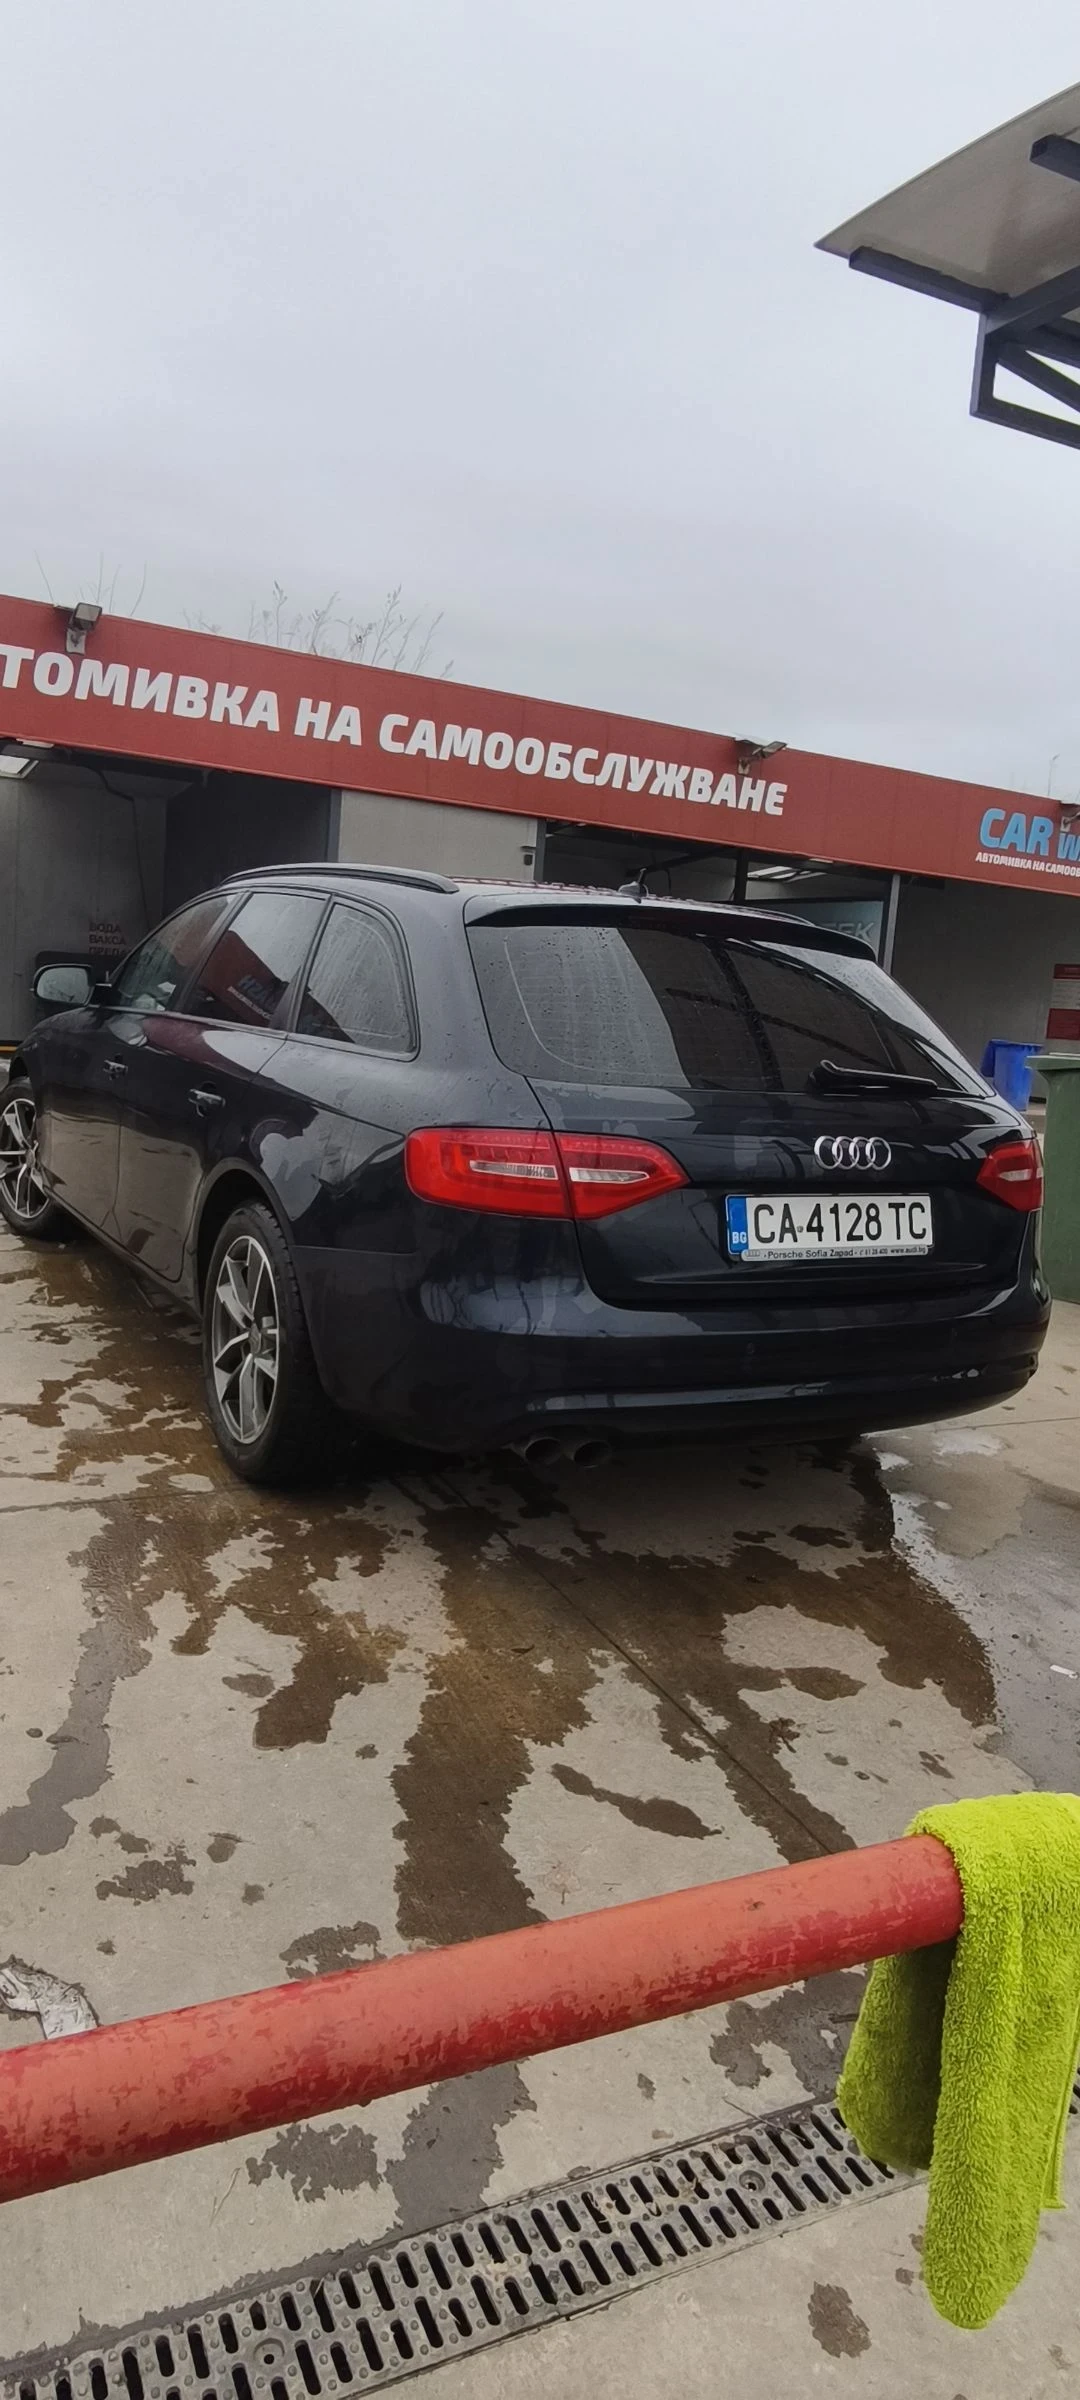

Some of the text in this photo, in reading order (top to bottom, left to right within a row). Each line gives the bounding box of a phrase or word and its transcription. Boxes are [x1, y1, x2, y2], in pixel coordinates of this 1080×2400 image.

[0, 643, 788, 816] ТОМИВКА НА САМООБСЛУЖВАНЕ
[980, 807, 1080, 862] CAR W
[975, 852, 1031, 870] АВТОМИВКА
[1032, 860, 1045, 872] НА
[732, 1231, 748, 1244] BG
[754, 1202, 927, 1244] CA 4128 TC
[767, 1250, 803, 1259] Porsche
[806, 1249, 828, 1258] Sofia
[829, 1248, 854, 1258] Zapad
